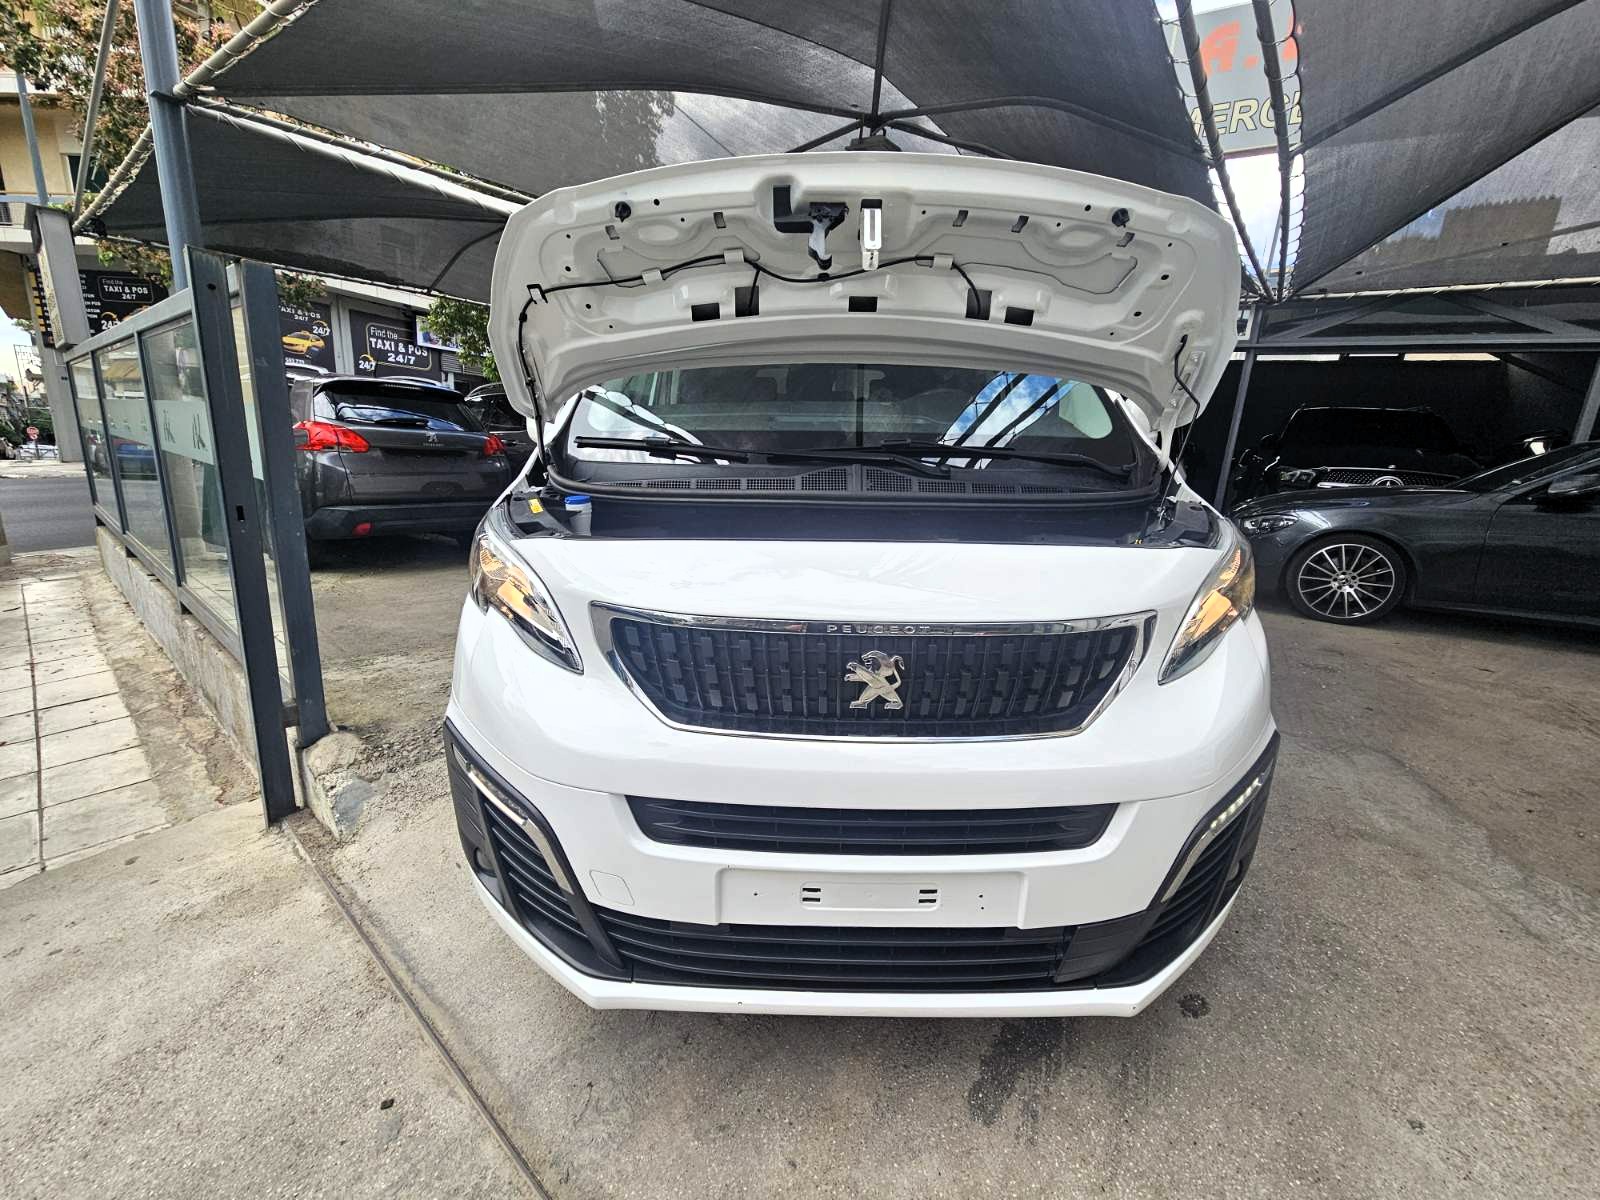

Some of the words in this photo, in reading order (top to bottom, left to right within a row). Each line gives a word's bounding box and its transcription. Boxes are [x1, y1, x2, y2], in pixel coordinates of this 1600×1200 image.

[103, 285, 123, 293] TAXI
[279, 305, 295, 314] AXI
[312, 326, 331, 336] 24/7
[370, 326, 386, 337] Find
[387, 330, 398, 340] the
[370, 338, 395, 352] TAXI
[398, 343, 405, 353] &
[408, 344, 428, 357] POS
[387, 352, 416, 365] 24/7
[358, 360, 376, 370] 24/7
[826, 624, 930, 634] PEUGEOT
